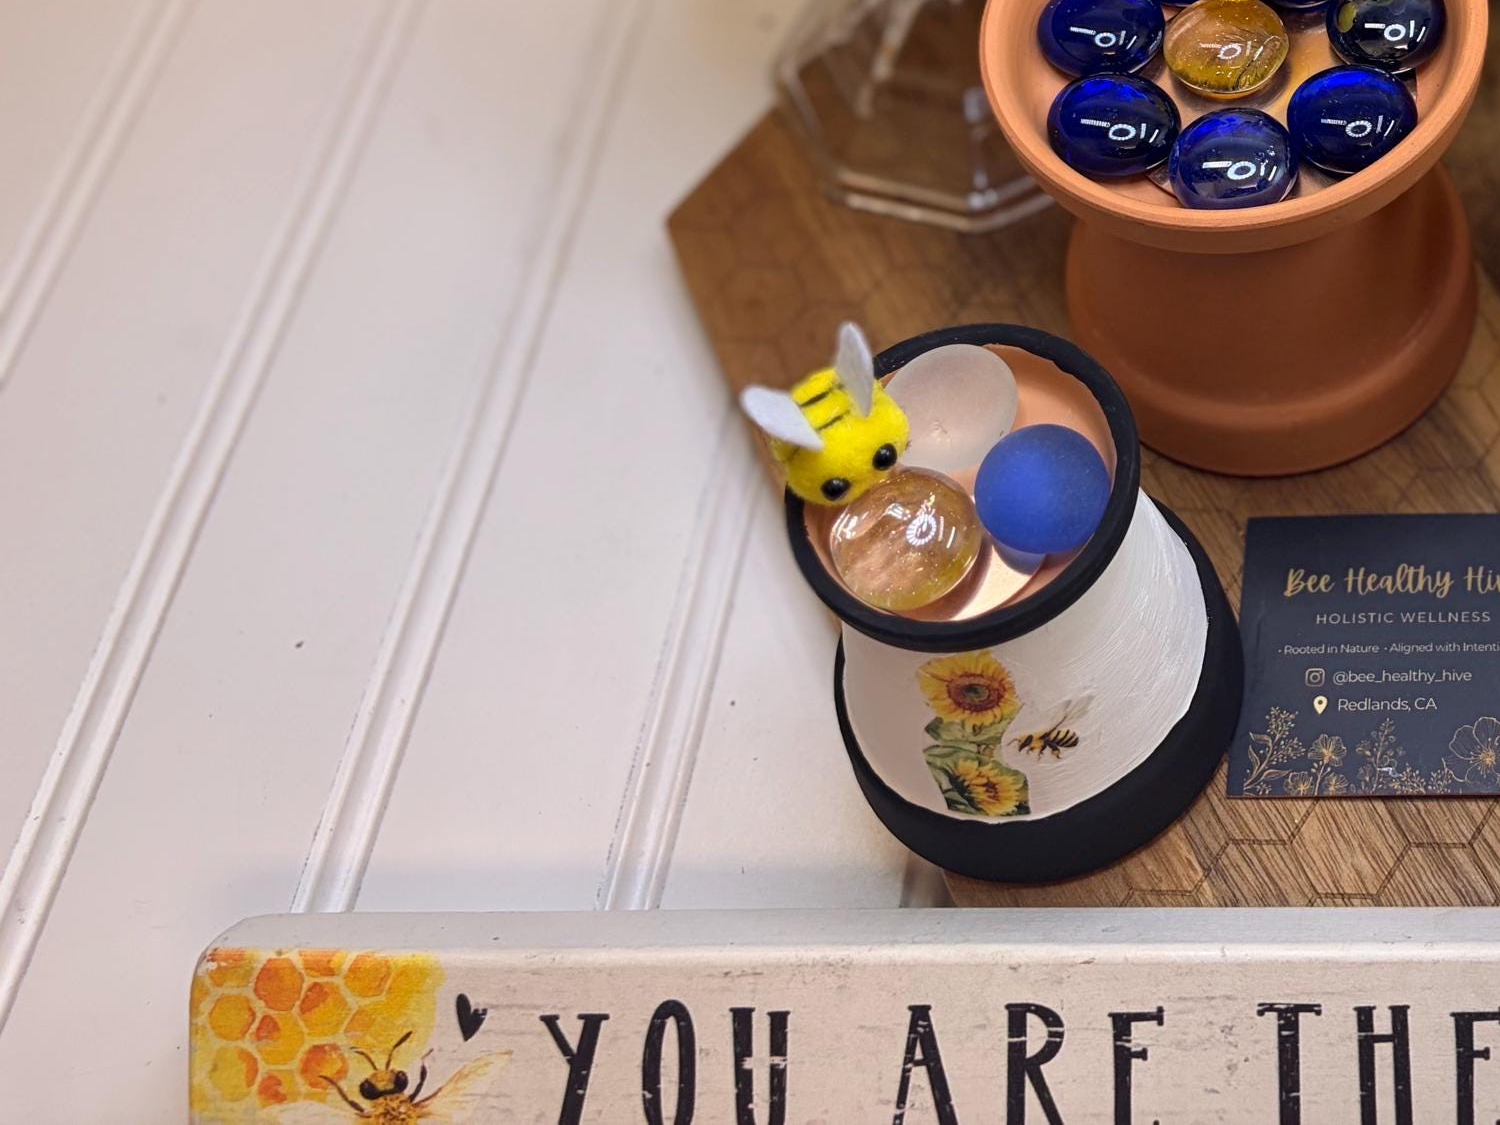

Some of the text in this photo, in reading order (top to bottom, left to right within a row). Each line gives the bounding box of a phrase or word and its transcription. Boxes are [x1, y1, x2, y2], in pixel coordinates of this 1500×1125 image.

[1283, 568, 1335, 597] Bee
[1345, 563, 1455, 598] Healthy
[1315, 611, 1492, 625] HOLISTIC WELLNESS
[1283, 643, 1325, 655] Rooted
[1327, 643, 1338, 654] in
[1340, 643, 1380, 654] Nature
[1389, 642, 1433, 655] Aligned
[1434, 642, 1461, 653] with
[1333, 669, 1473, 686] @bee_healthy_hive
[1337, 697, 1438, 713] Redlands, CA
[538, 999, 793, 1125] YOU
[892, 1003, 1166, 1125] ARE
